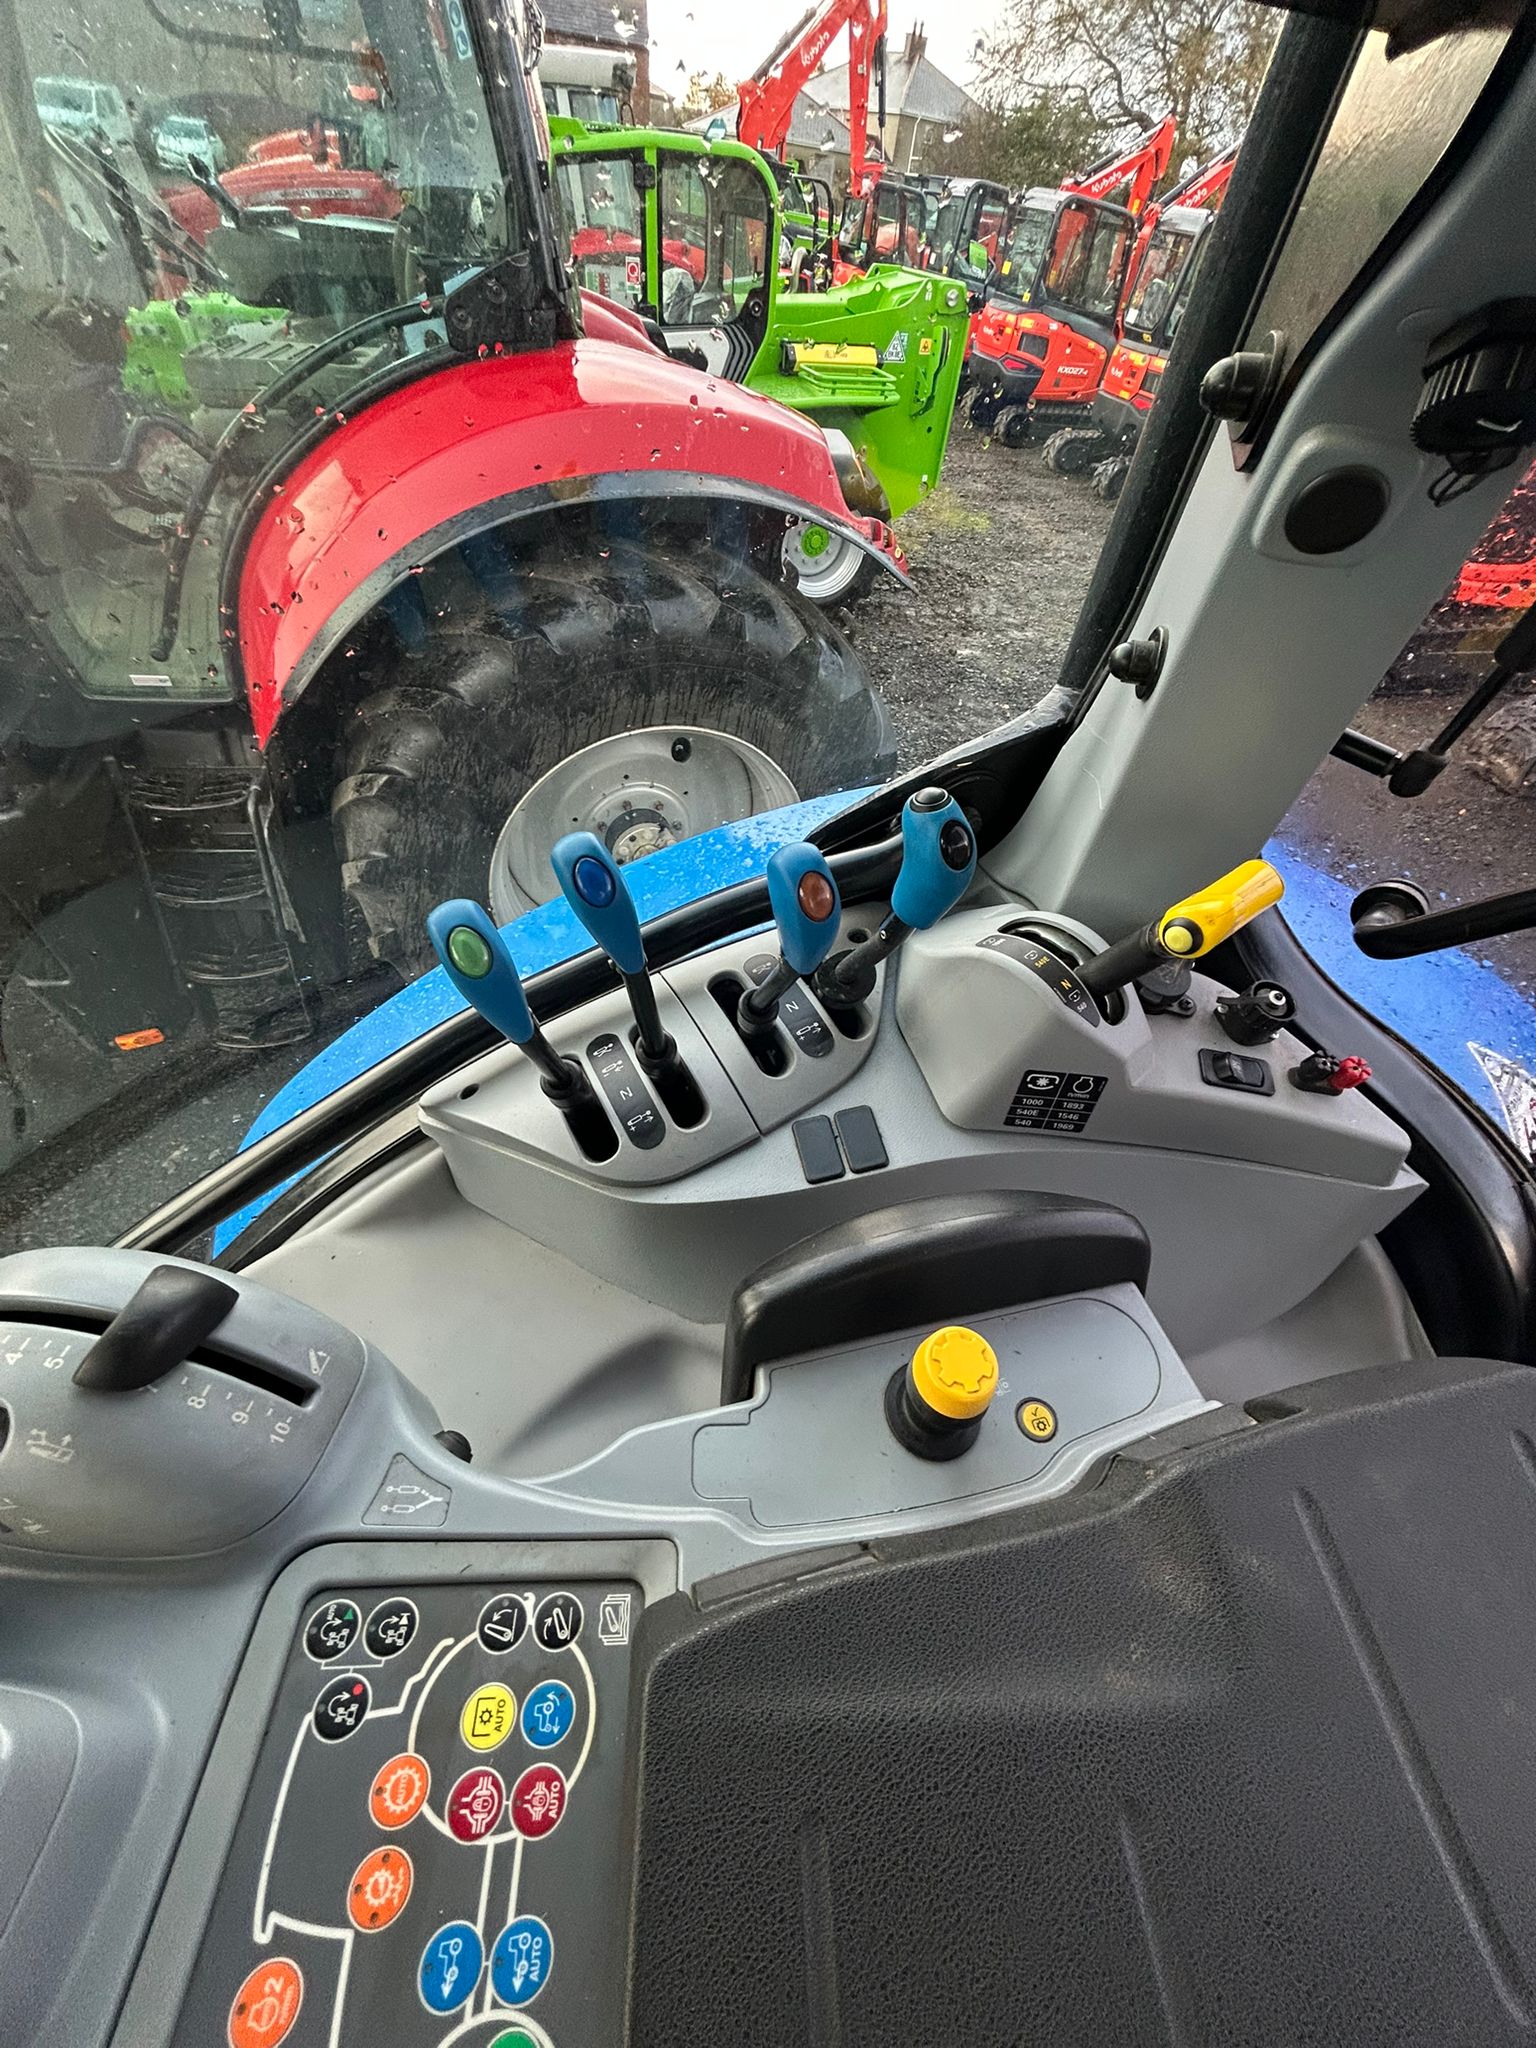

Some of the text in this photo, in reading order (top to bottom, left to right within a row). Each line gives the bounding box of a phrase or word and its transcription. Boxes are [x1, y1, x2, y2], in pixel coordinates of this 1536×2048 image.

[800, 31, 830, 68] Kubota
[1091, 170, 1123, 193] Kubota
[1060, 978, 1073, 990] N
[785, 1000, 800, 1013] N
[619, 1086, 633, 1101] N
[1022, 1098, 1085, 1110] 1000 1893
[1016, 1108, 1080, 1120] 540E 1546
[1053, 1122, 1075, 1130] 1969
[5, 1351, 23, 1366] 4
[43, 1357, 65, 1370] 5
[187, 1396, 206, 1409] 8
[231, 1411, 249, 1424] 9
[269, 1422, 290, 1443] 10
[326, 1604, 337, 1620] AUTO
[494, 1699, 506, 1732] AUTO
[396, 1773, 409, 1804] AUTO
[549, 1781, 560, 1819] AUTO
[530, 1936, 543, 1982] AUTO
[264, 1976, 284, 1993] 2
